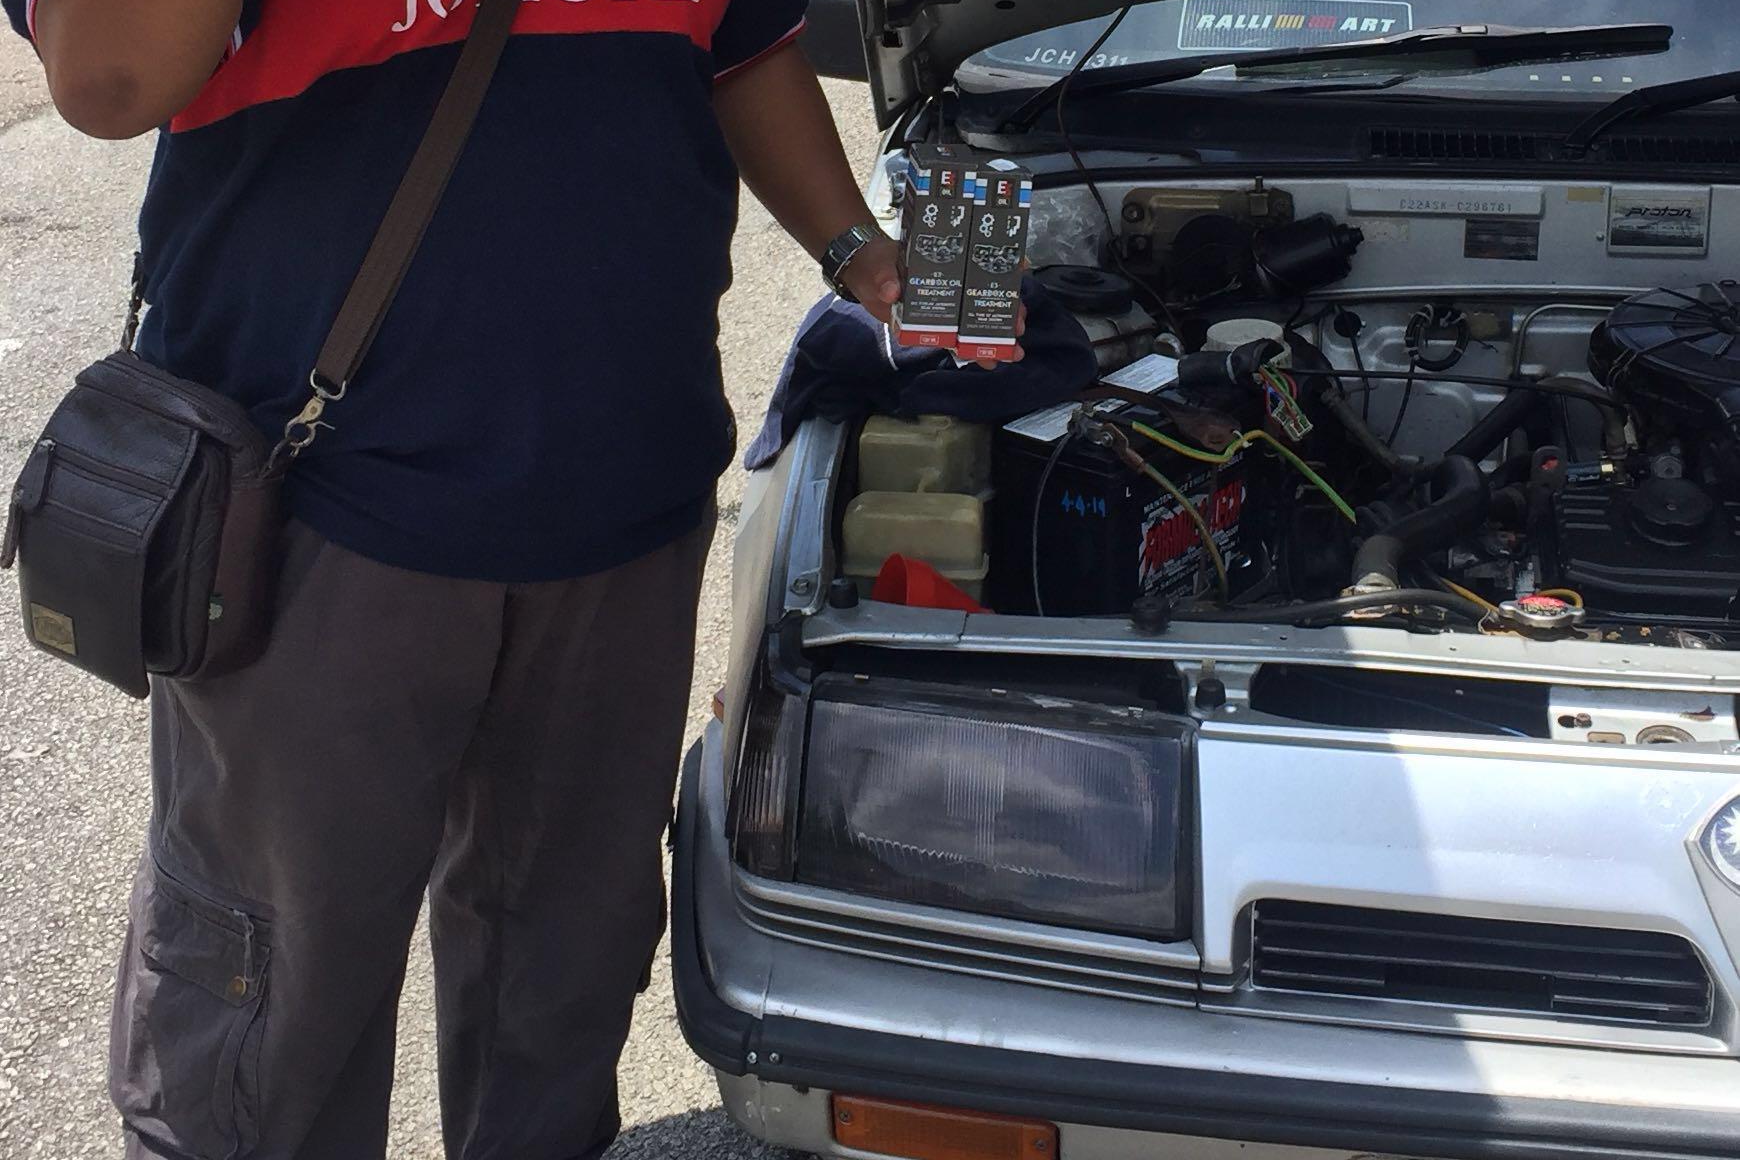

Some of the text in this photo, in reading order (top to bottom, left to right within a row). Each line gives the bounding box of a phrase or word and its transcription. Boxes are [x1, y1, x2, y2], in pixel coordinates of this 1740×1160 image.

[1195, 14, 1397, 32] RALLI ART
[1024, 47, 1077, 65] JCH
[909, 277, 962, 287] GEARBOX OIL
[917, 288, 956, 297] TREATMENT
[966, 288, 1019, 299] GEARBOX OIL
[974, 299, 1012, 308] TREATMENT
